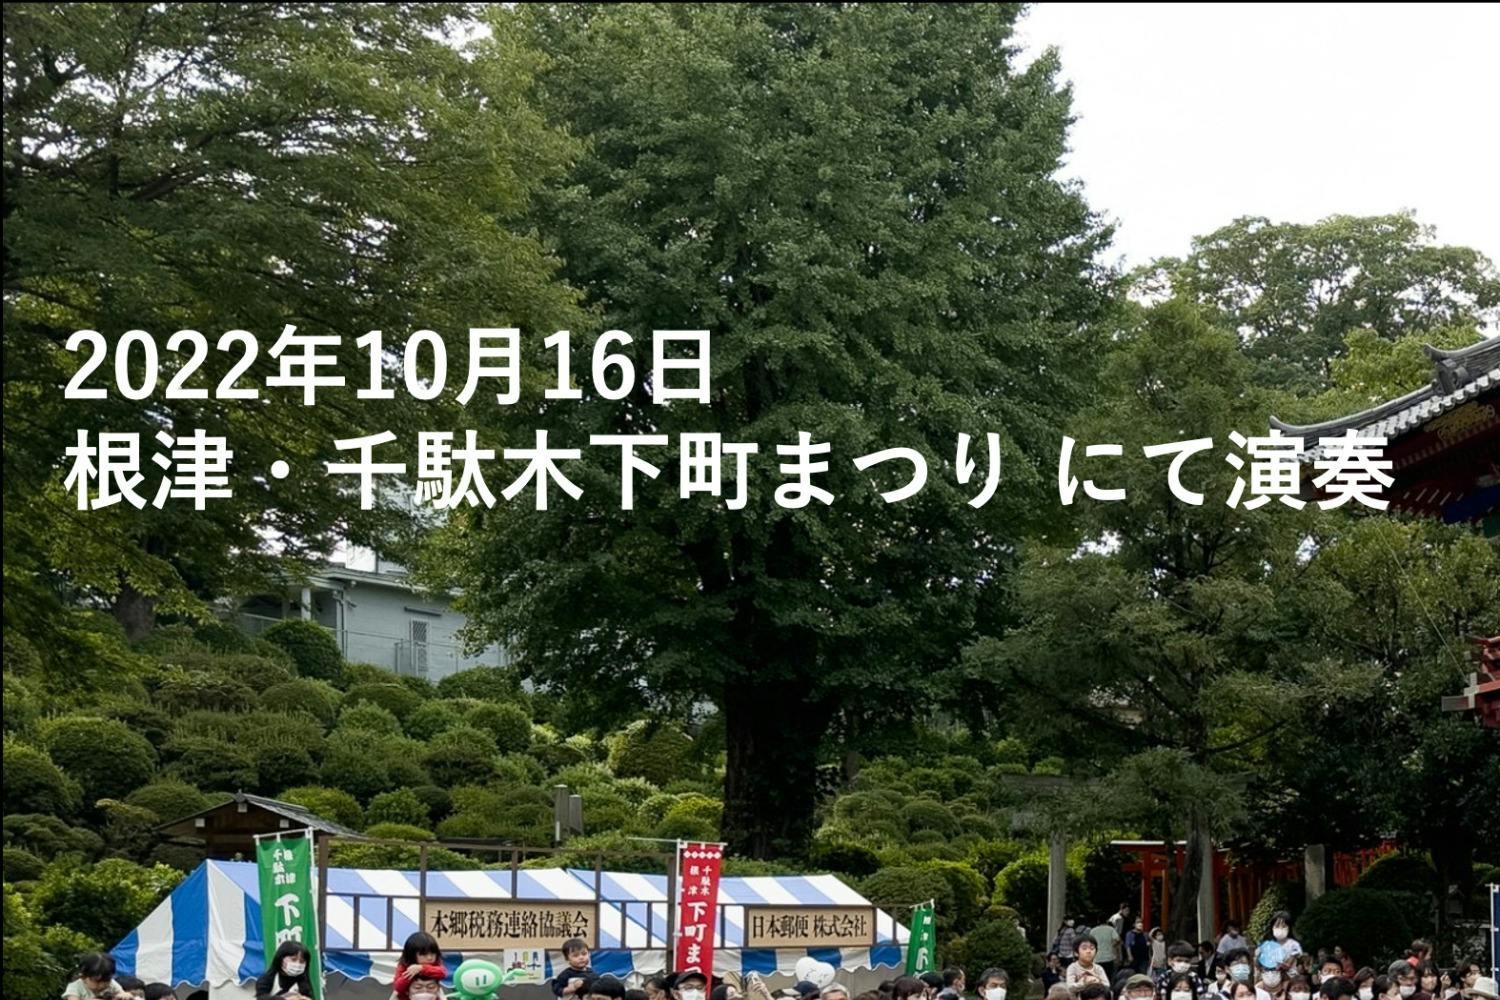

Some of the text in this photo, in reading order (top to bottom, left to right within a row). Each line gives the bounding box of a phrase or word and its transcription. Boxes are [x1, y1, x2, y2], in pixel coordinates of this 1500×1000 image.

[431, 909, 589, 939] 本郷税務連絡協議会
[752, 913, 867, 939] 日本郵便 株式会社
